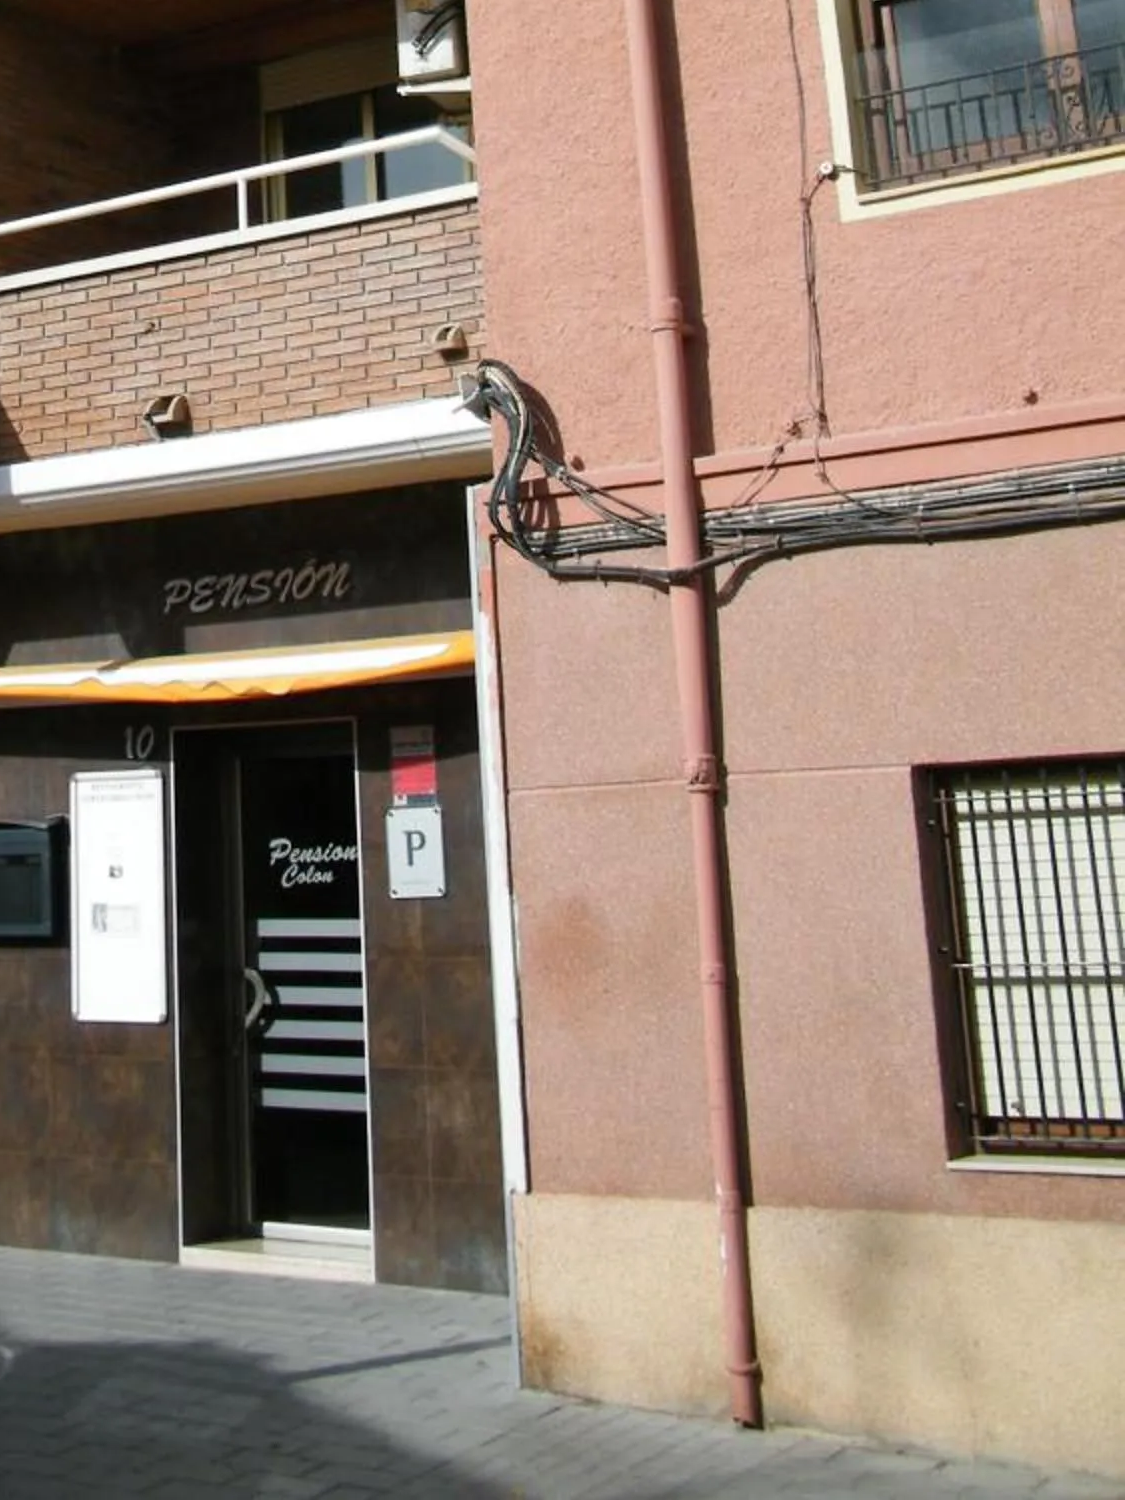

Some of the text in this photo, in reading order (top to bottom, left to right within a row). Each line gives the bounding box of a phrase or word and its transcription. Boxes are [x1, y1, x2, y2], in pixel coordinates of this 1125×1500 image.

[163, 558, 351, 615] PENSIÓN
[122, 724, 156, 761] 10
[269, 838, 359, 867] Pension
[402, 829, 427, 868] P
[281, 863, 334, 888] Colon
